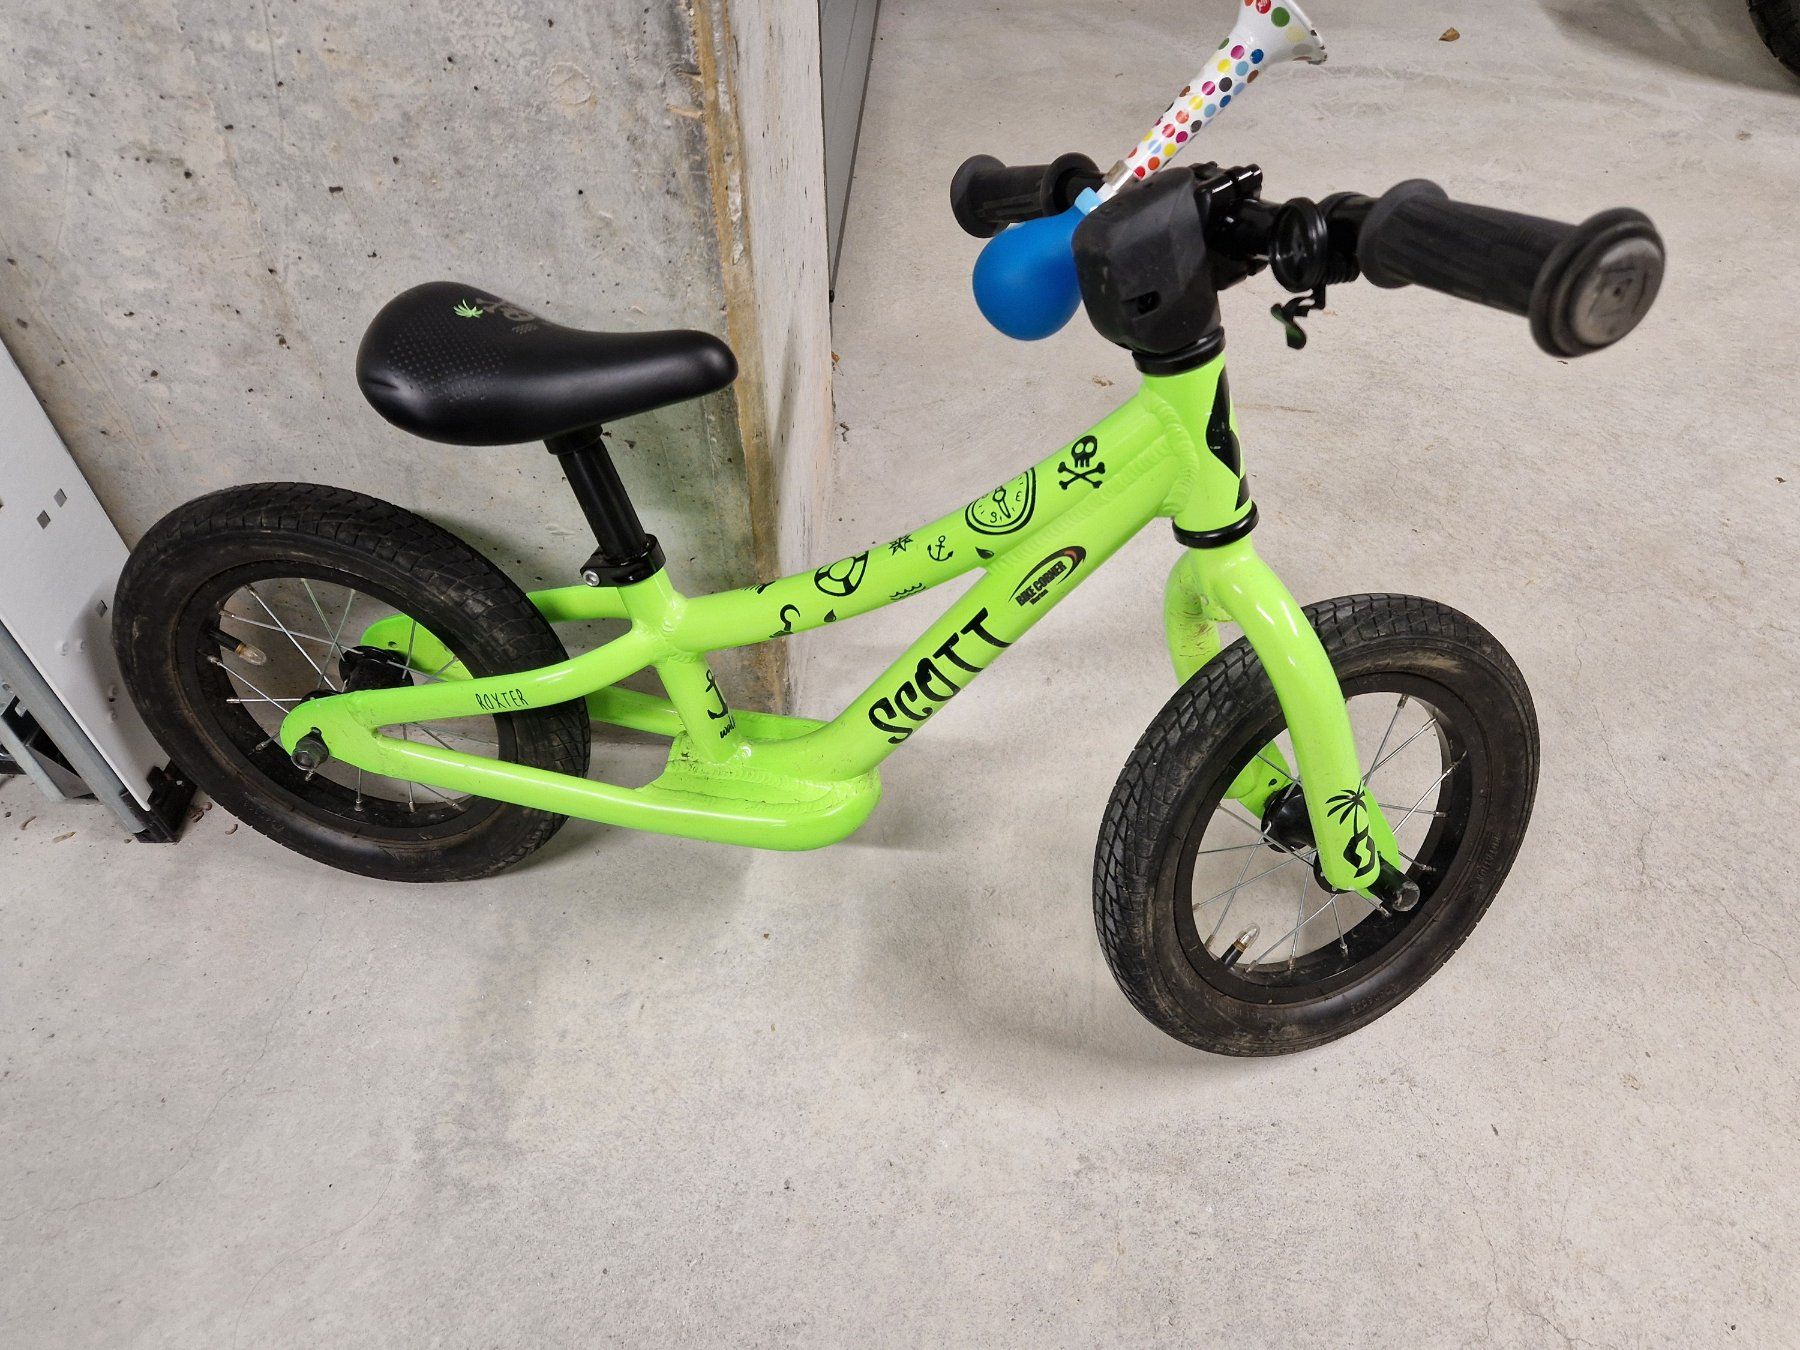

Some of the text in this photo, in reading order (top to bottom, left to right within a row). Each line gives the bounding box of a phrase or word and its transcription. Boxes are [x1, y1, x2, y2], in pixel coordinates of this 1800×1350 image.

[1033, 561, 1067, 591] CORNER
[868, 607, 1013, 744] SCOTT
[475, 688, 529, 711] ROXTER
